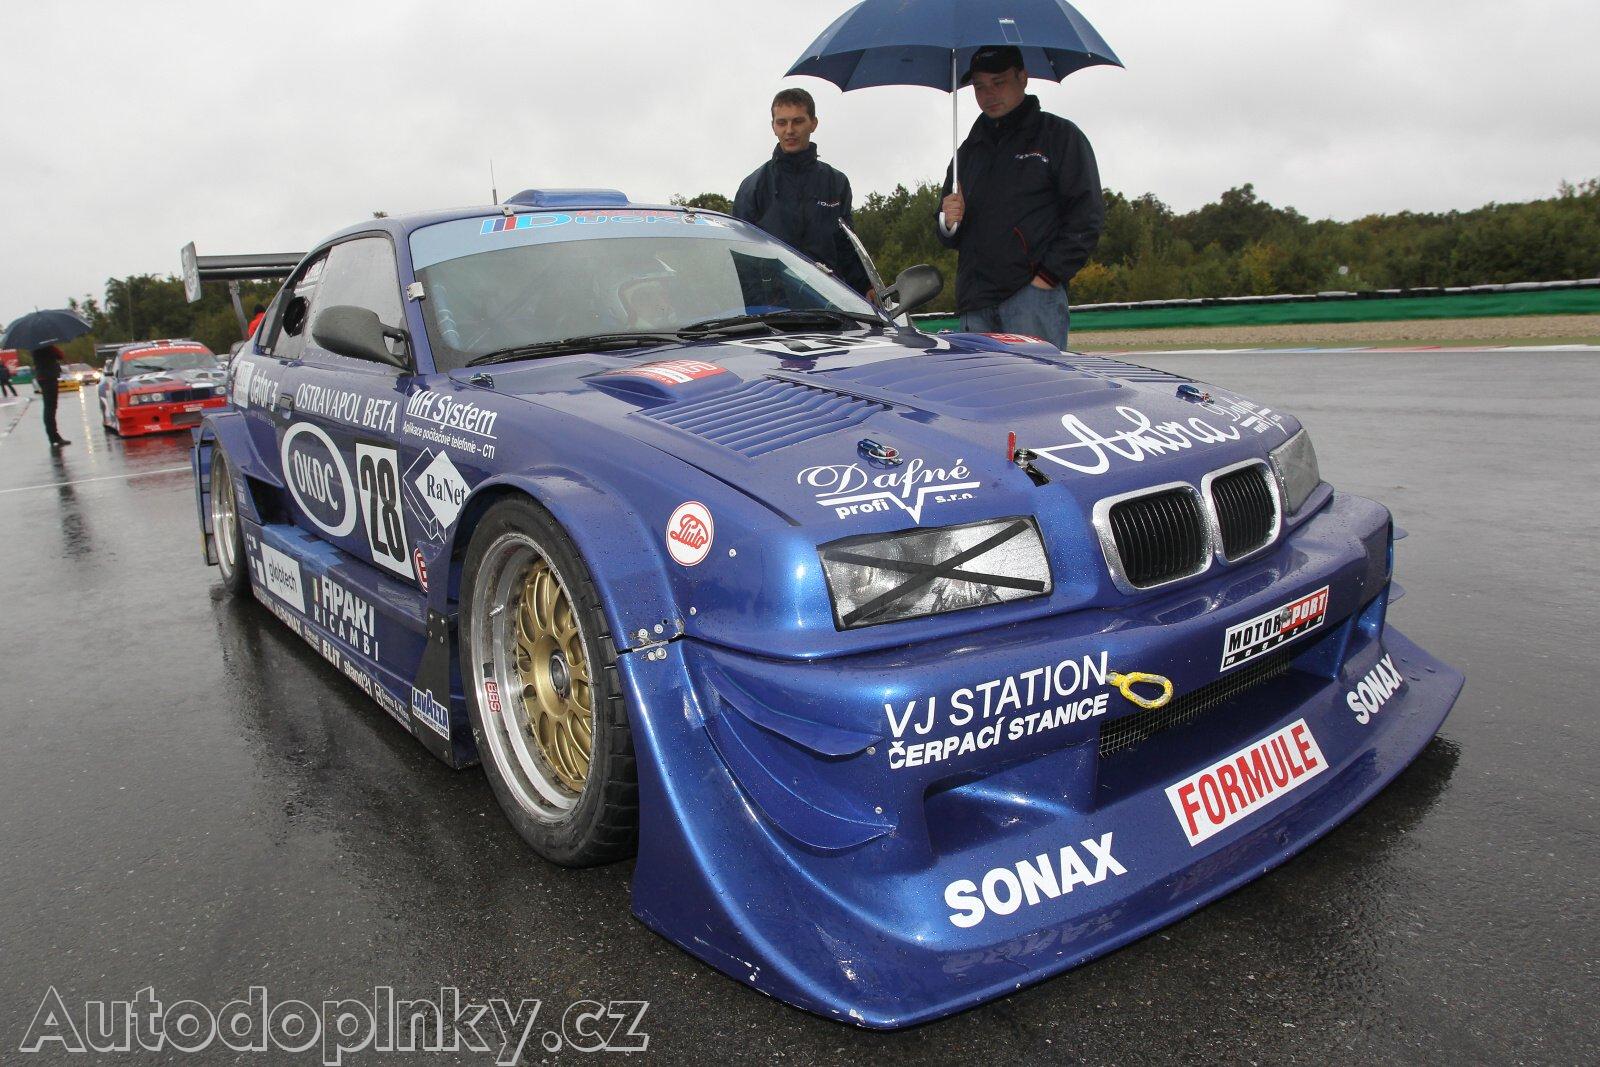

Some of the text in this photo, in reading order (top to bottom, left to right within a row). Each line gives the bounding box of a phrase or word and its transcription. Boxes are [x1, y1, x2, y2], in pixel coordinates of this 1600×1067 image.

[296, 383, 361, 423] OSTRAVAPOL
[362, 398, 398, 434] BETA
[406, 389, 498, 434] MH System
[294, 449, 339, 511] OKDC
[482, 443, 496, 460] CTI
[797, 458, 971, 500] Dafné
[360, 454, 406, 563] 28
[426, 473, 466, 506] RaNet
[835, 498, 890, 520] profi
[314, 604, 379, 662] RICAMBI
[321, 574, 375, 638] FIPAKI
[884, 651, 1108, 738] VJ STATION
[1346, 653, 1404, 726] SONAX
[888, 693, 1110, 770] ČERPACÍ STANICE
[1177, 724, 1318, 837] FORMULE
[944, 831, 1129, 928] SONAX
